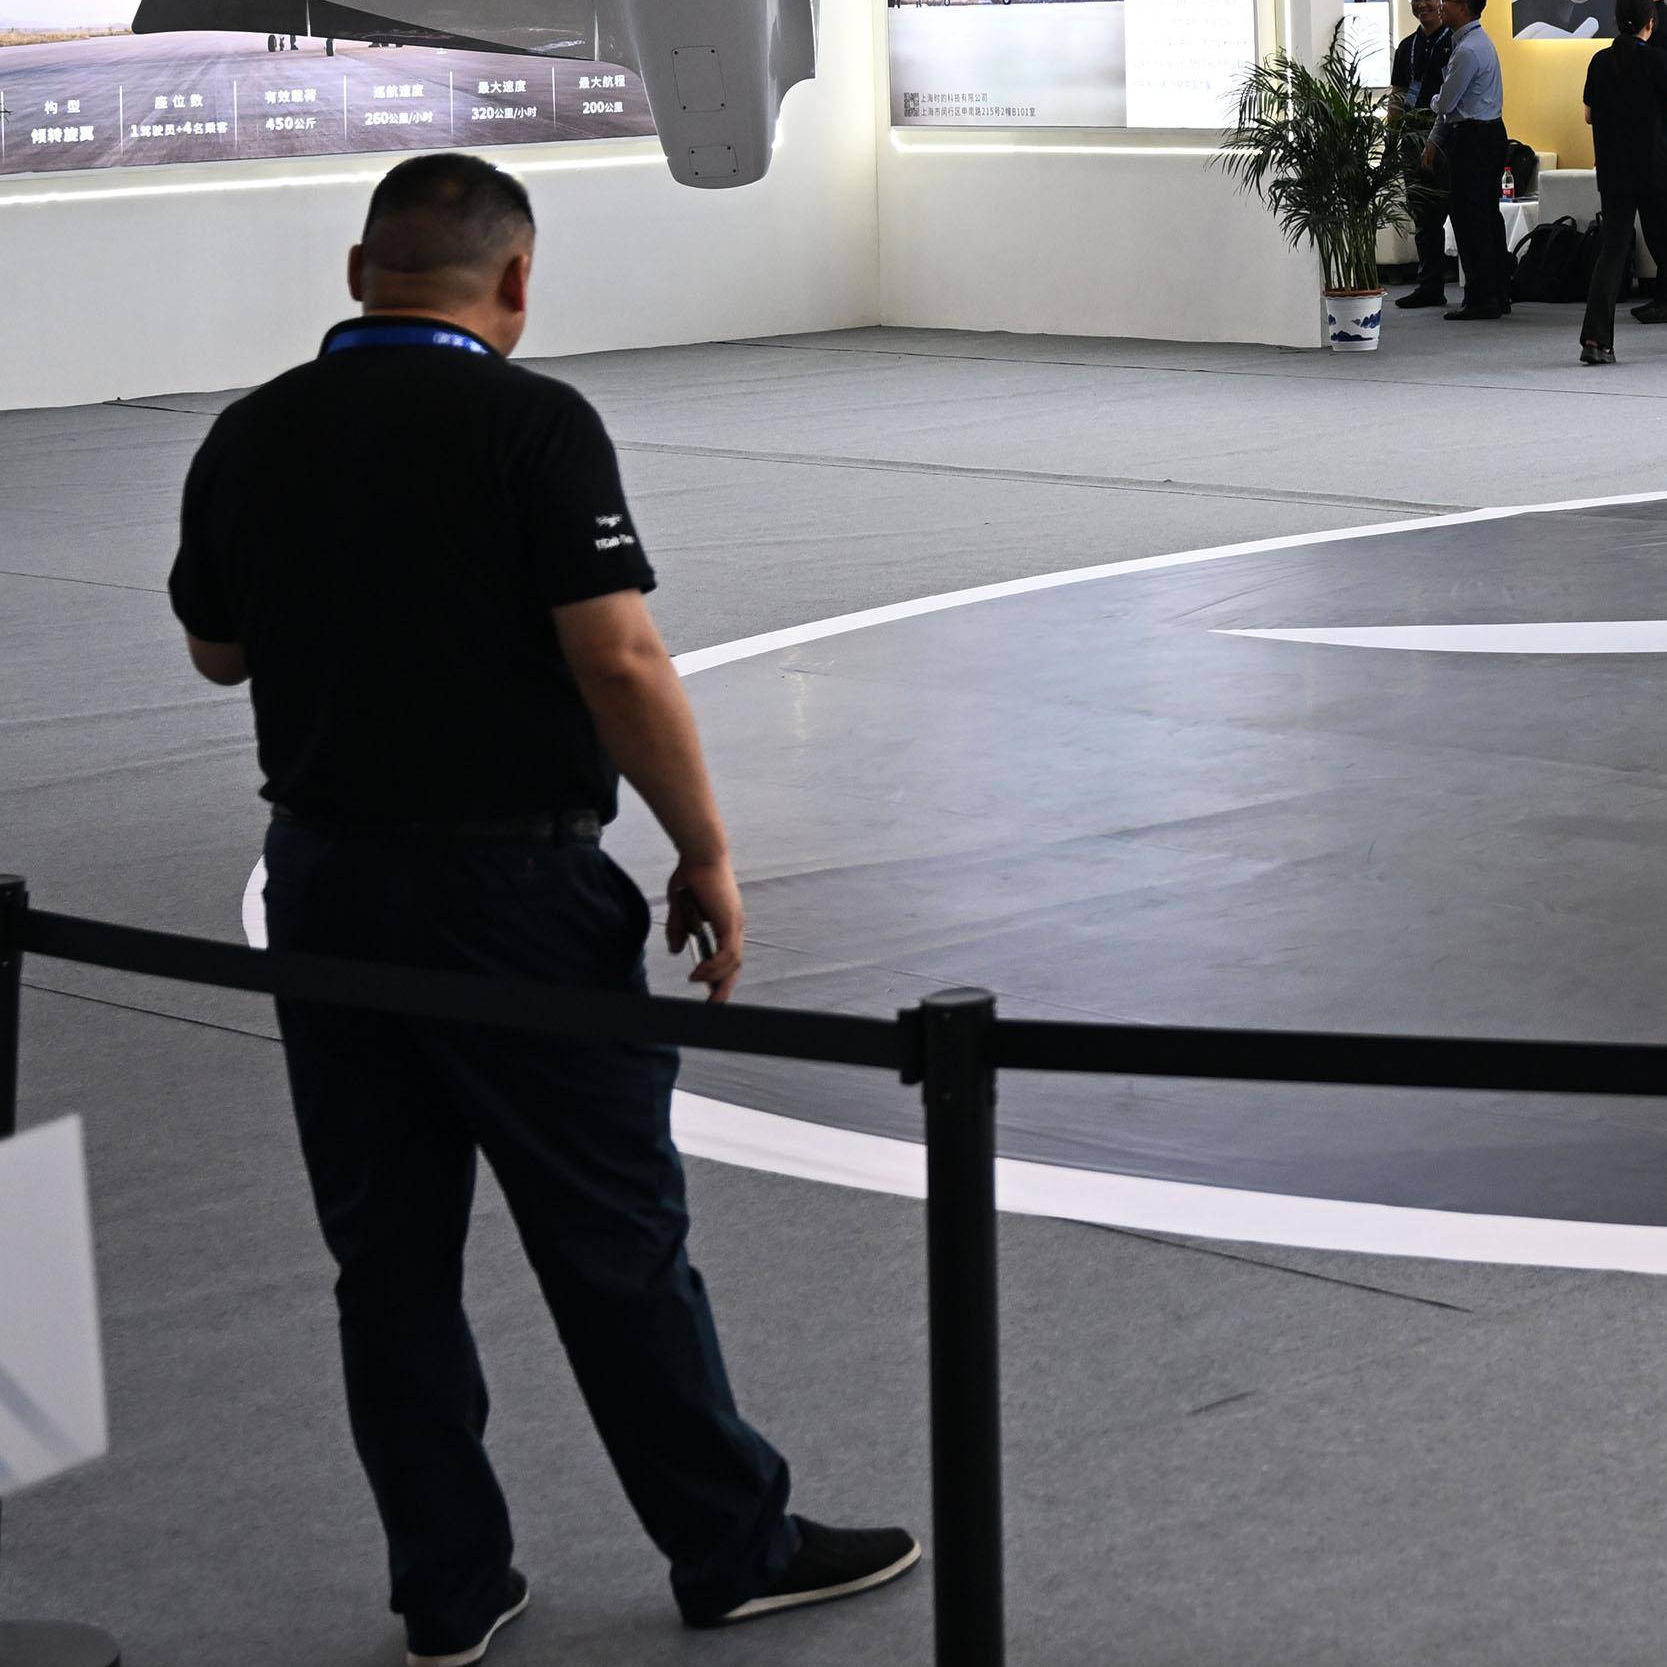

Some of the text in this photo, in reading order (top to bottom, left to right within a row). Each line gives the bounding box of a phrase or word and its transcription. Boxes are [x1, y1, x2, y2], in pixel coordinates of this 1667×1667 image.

[478, 80, 527, 94] 最大速度
[579, 75, 626, 89] 最大航程
[921, 93, 988, 103] 上海时的科技有限公司
[471, 106, 537, 120] 320公里/小时
[582, 101, 624, 114] 200公里
[265, 117, 317, 131] 450公斤
[365, 111, 434, 126] 260公里/小时
